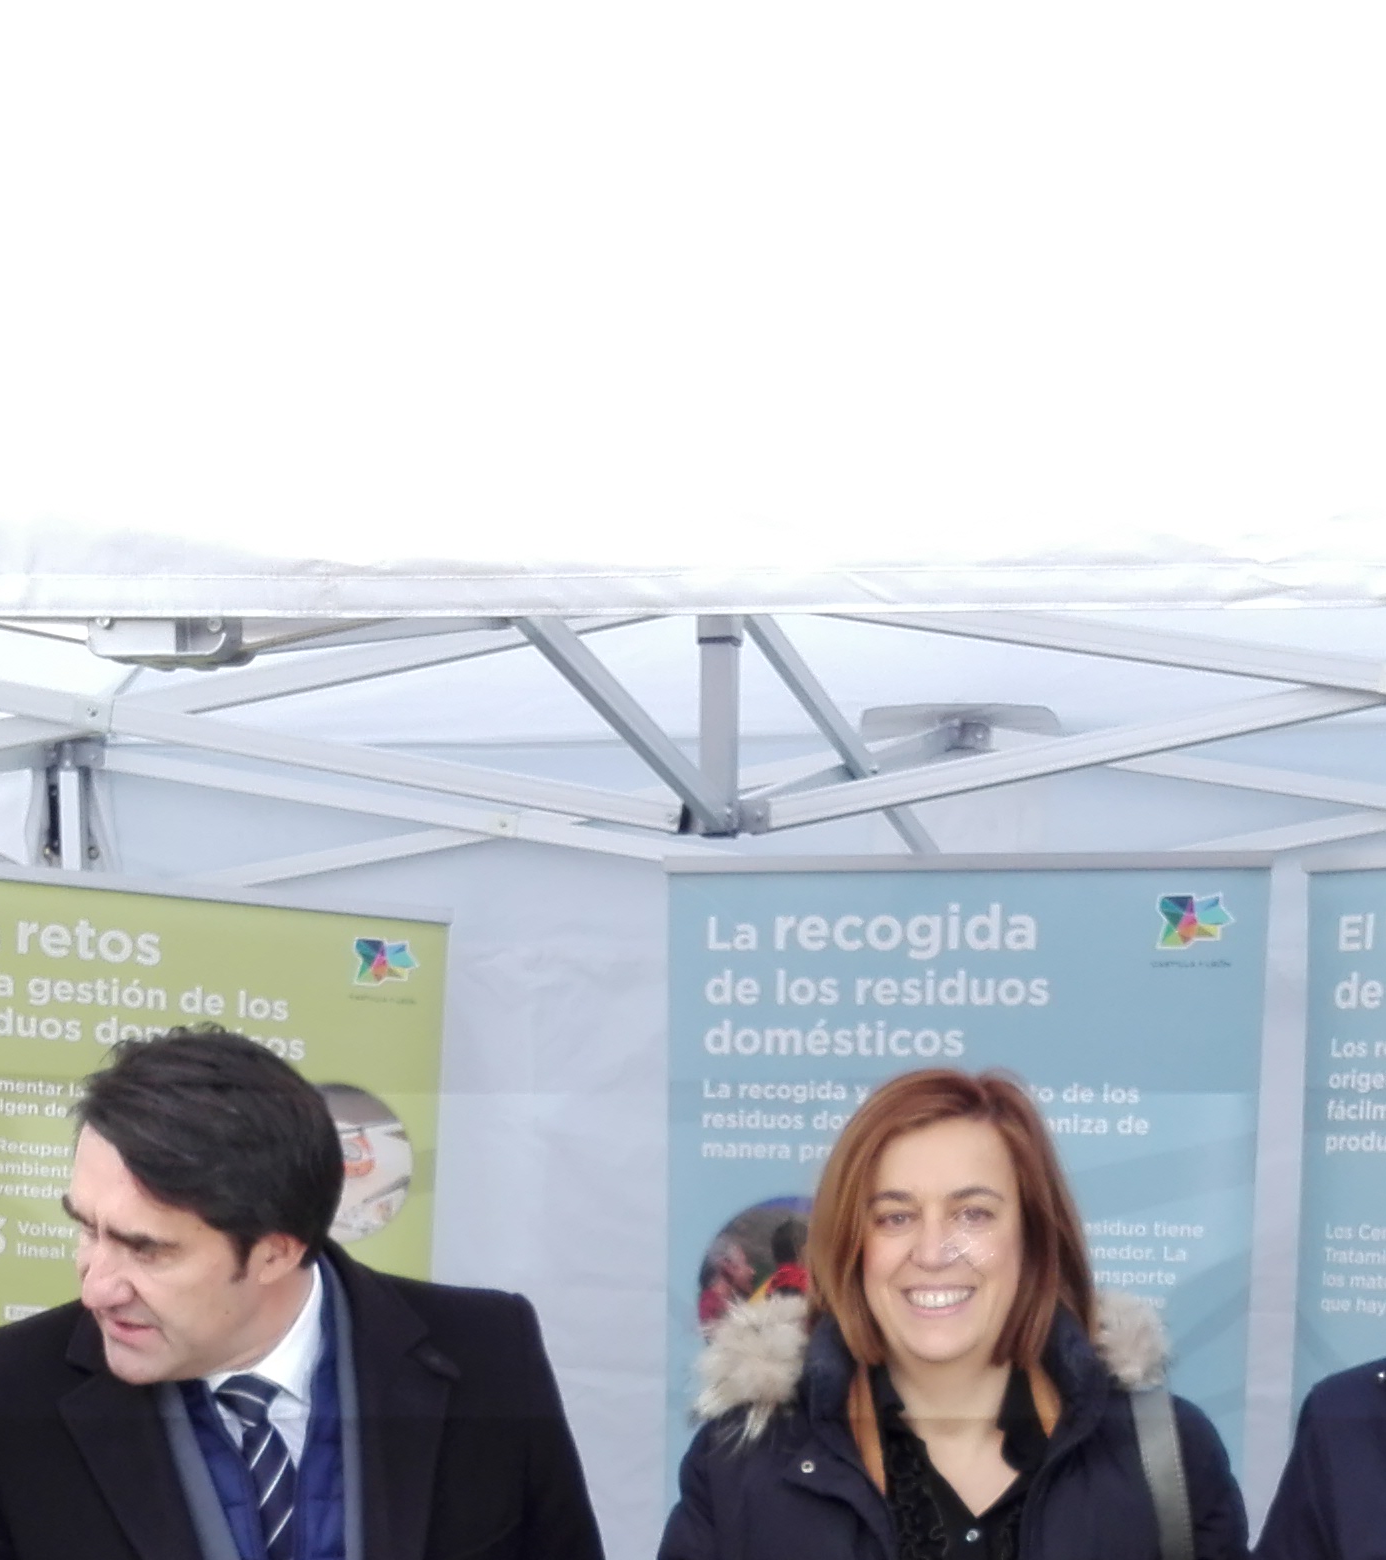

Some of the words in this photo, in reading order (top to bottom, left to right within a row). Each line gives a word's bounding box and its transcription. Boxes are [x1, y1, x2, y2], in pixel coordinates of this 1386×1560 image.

[706, 915, 757, 952] La
[774, 903, 1038, 959] recogida
[1338, 913, 1374, 952] El
[16, 918, 163, 967] retos
[704, 970, 761, 1006] de
[776, 969, 839, 1006] los
[855, 969, 1050, 1006] residuos
[1334, 972, 1383, 1009] de
[28, 977, 167, 1012] gestión
[179, 985, 225, 1016] de
[239, 990, 290, 1022] los
[704, 1019, 964, 1057] domésticos
[1330, 1037, 1368, 1058] Los
[703, 1079, 730, 1098] La
[738, 1080, 847, 1103] recogida
[855, 1086, 870, 1104] y
[1063, 1082, 1094, 1103] de
[1103, 1082, 1140, 1104] los
[45, 1103, 68, 1118] de
[702, 1110, 805, 1130] residuos
[1117, 1113, 1149, 1135] de
[702, 1142, 791, 1158] manera
[17, 1221, 73, 1239] Volver
[1154, 1221, 1204, 1238] tiene
[1325, 1224, 1353, 1240] Los
[17, 1242, 65, 1259] lineal
[1163, 1246, 1188, 1262] La
[1323, 1272, 1345, 1287] los
[1320, 1298, 1350, 1314] que
